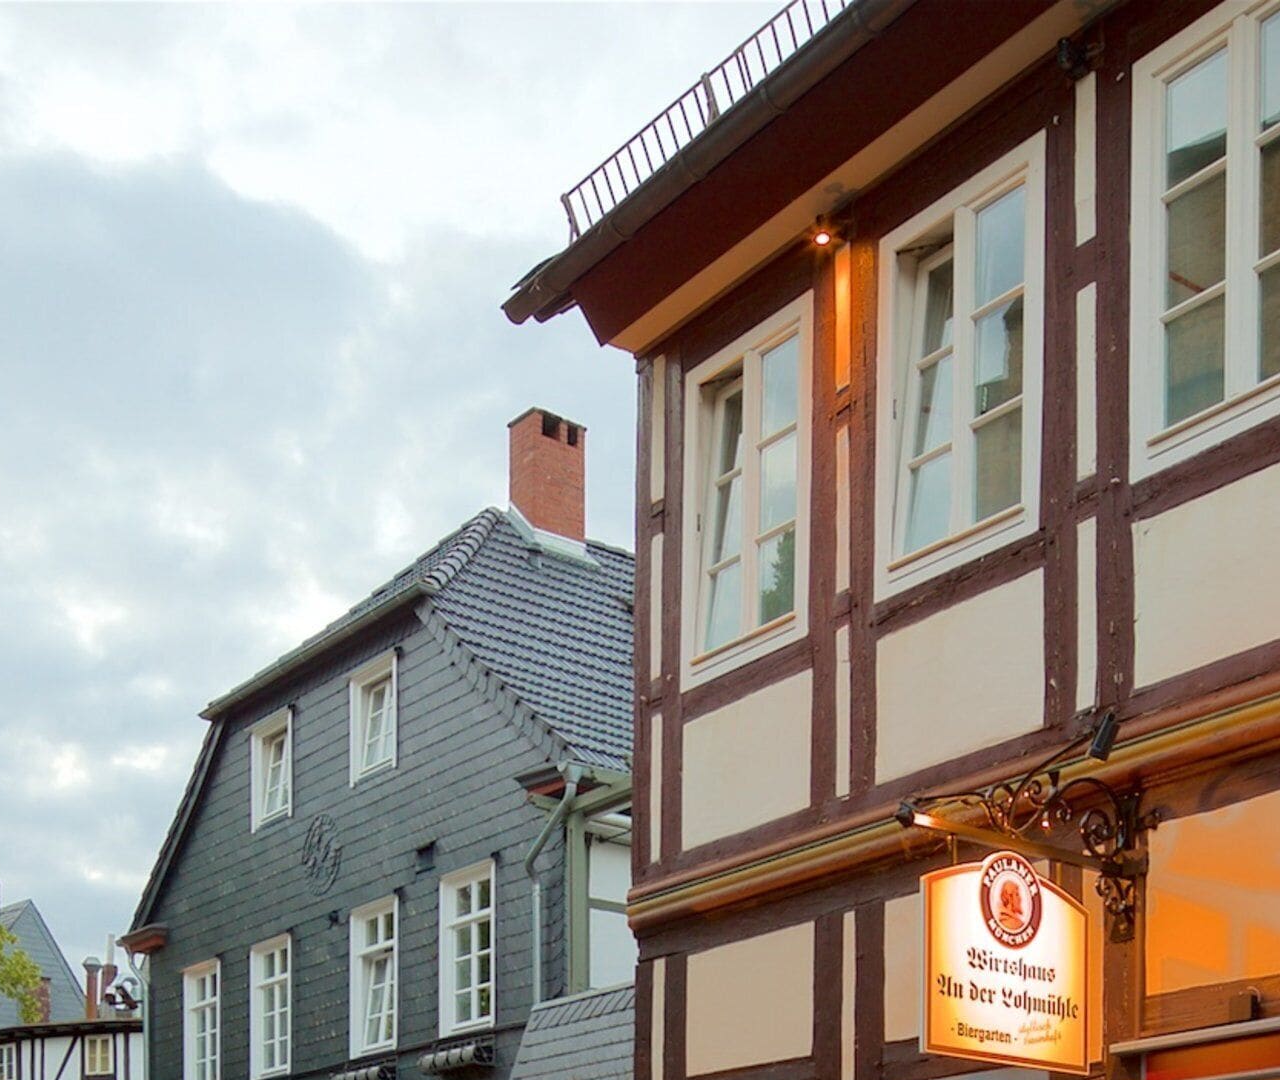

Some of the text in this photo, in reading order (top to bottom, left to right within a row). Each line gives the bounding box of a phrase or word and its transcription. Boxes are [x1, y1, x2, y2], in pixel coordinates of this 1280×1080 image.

[984, 858, 1038, 896] PAULANER
[967, 947, 1056, 982] Wirtshaus
[937, 973, 1079, 1021] An der Lohmühle
[957, 1022, 1012, 1043] Biergarten
